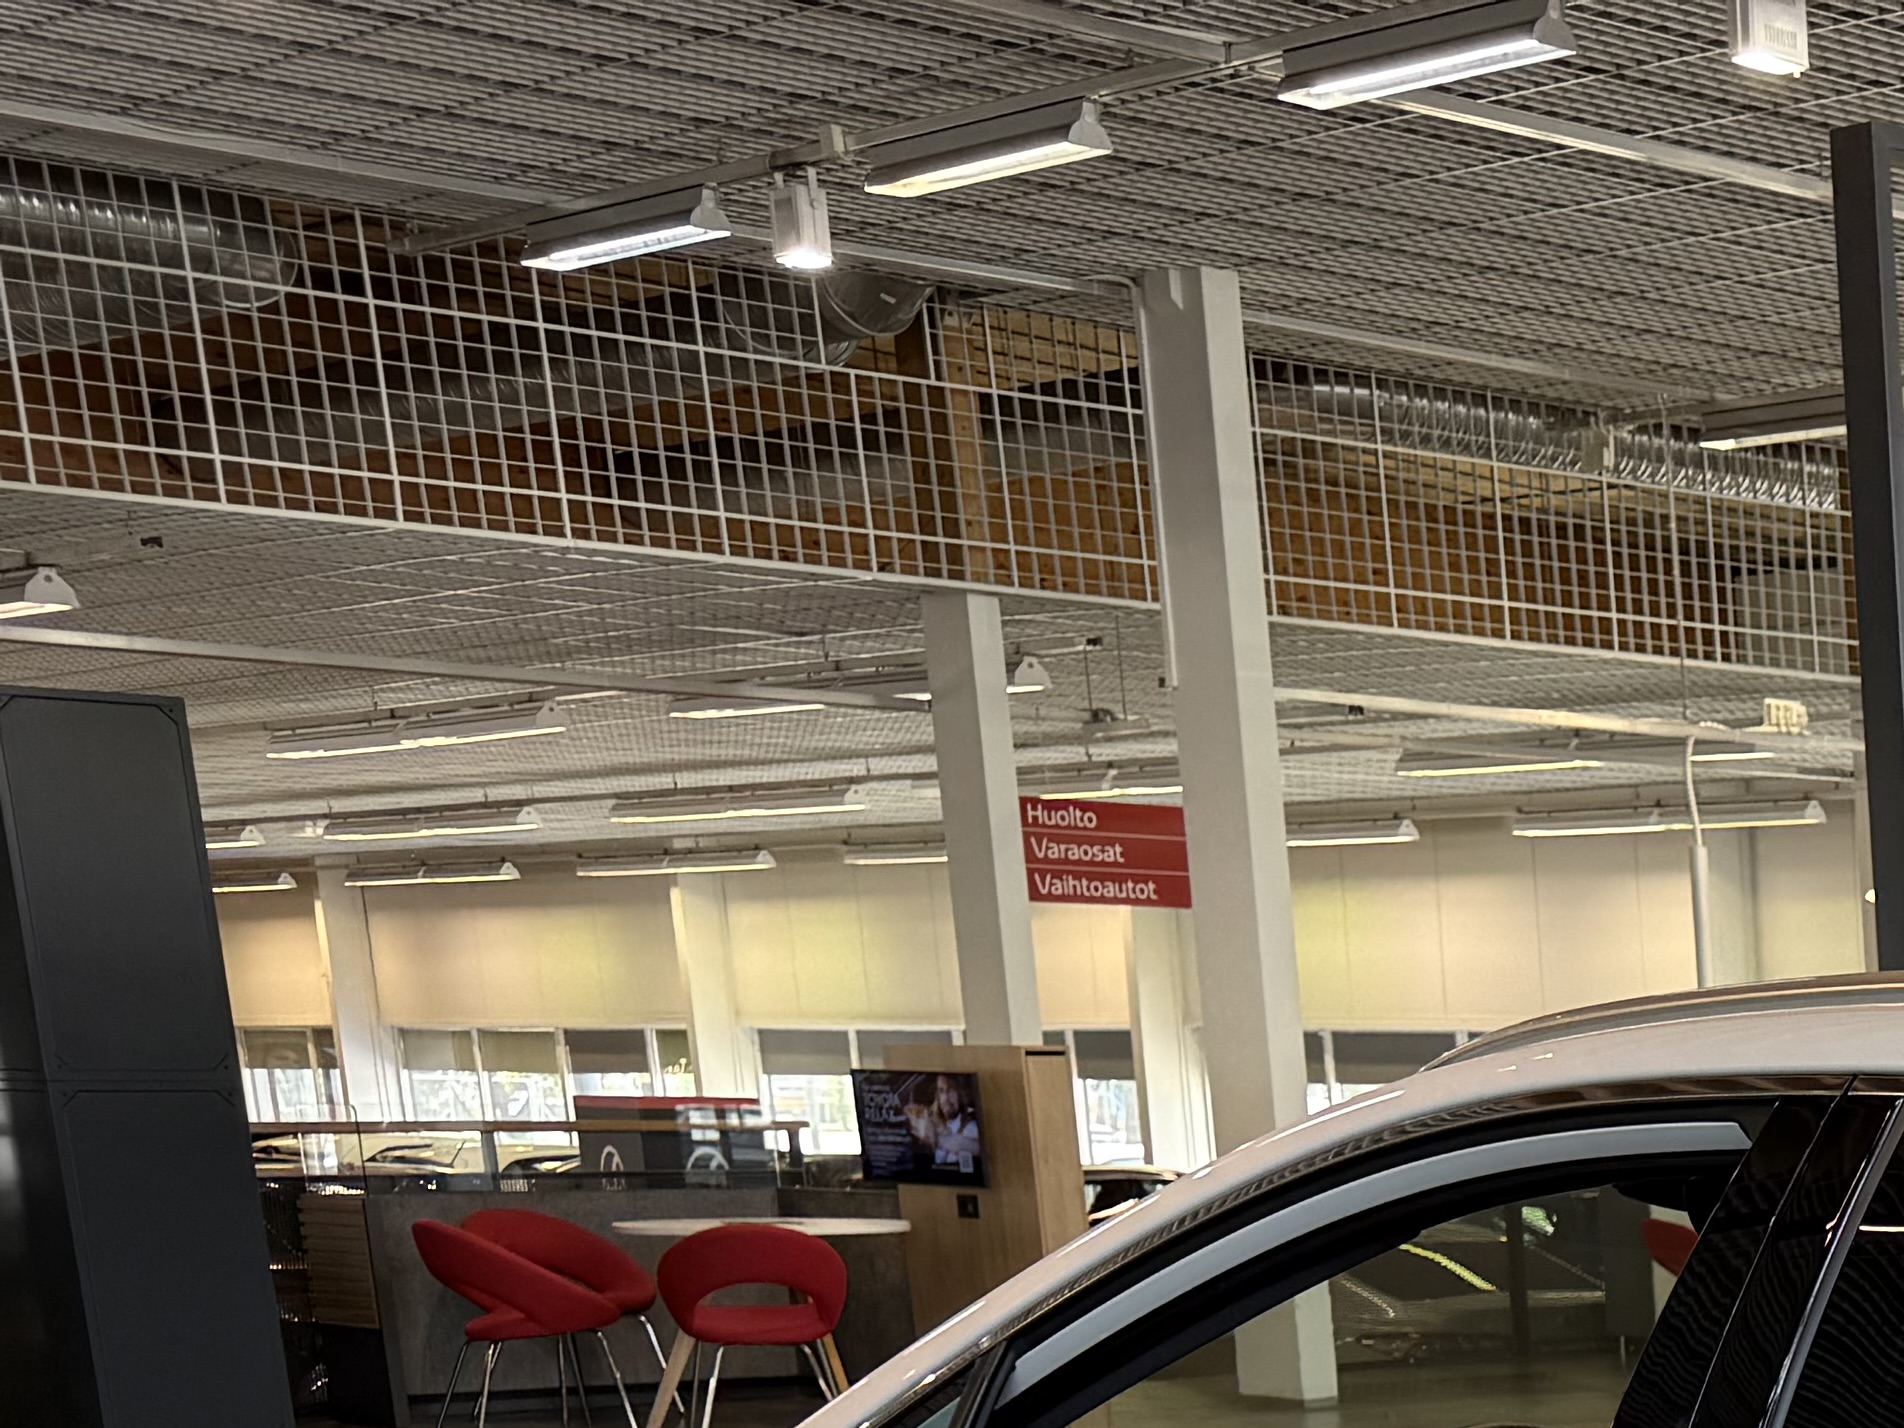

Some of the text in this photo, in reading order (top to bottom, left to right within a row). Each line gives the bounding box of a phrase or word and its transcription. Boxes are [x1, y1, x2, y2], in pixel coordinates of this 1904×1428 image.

[1027, 803, 1097, 828] Huolto
[1030, 836, 1125, 863] Varaosat
[1034, 872, 1159, 900] Vaihtoautot
